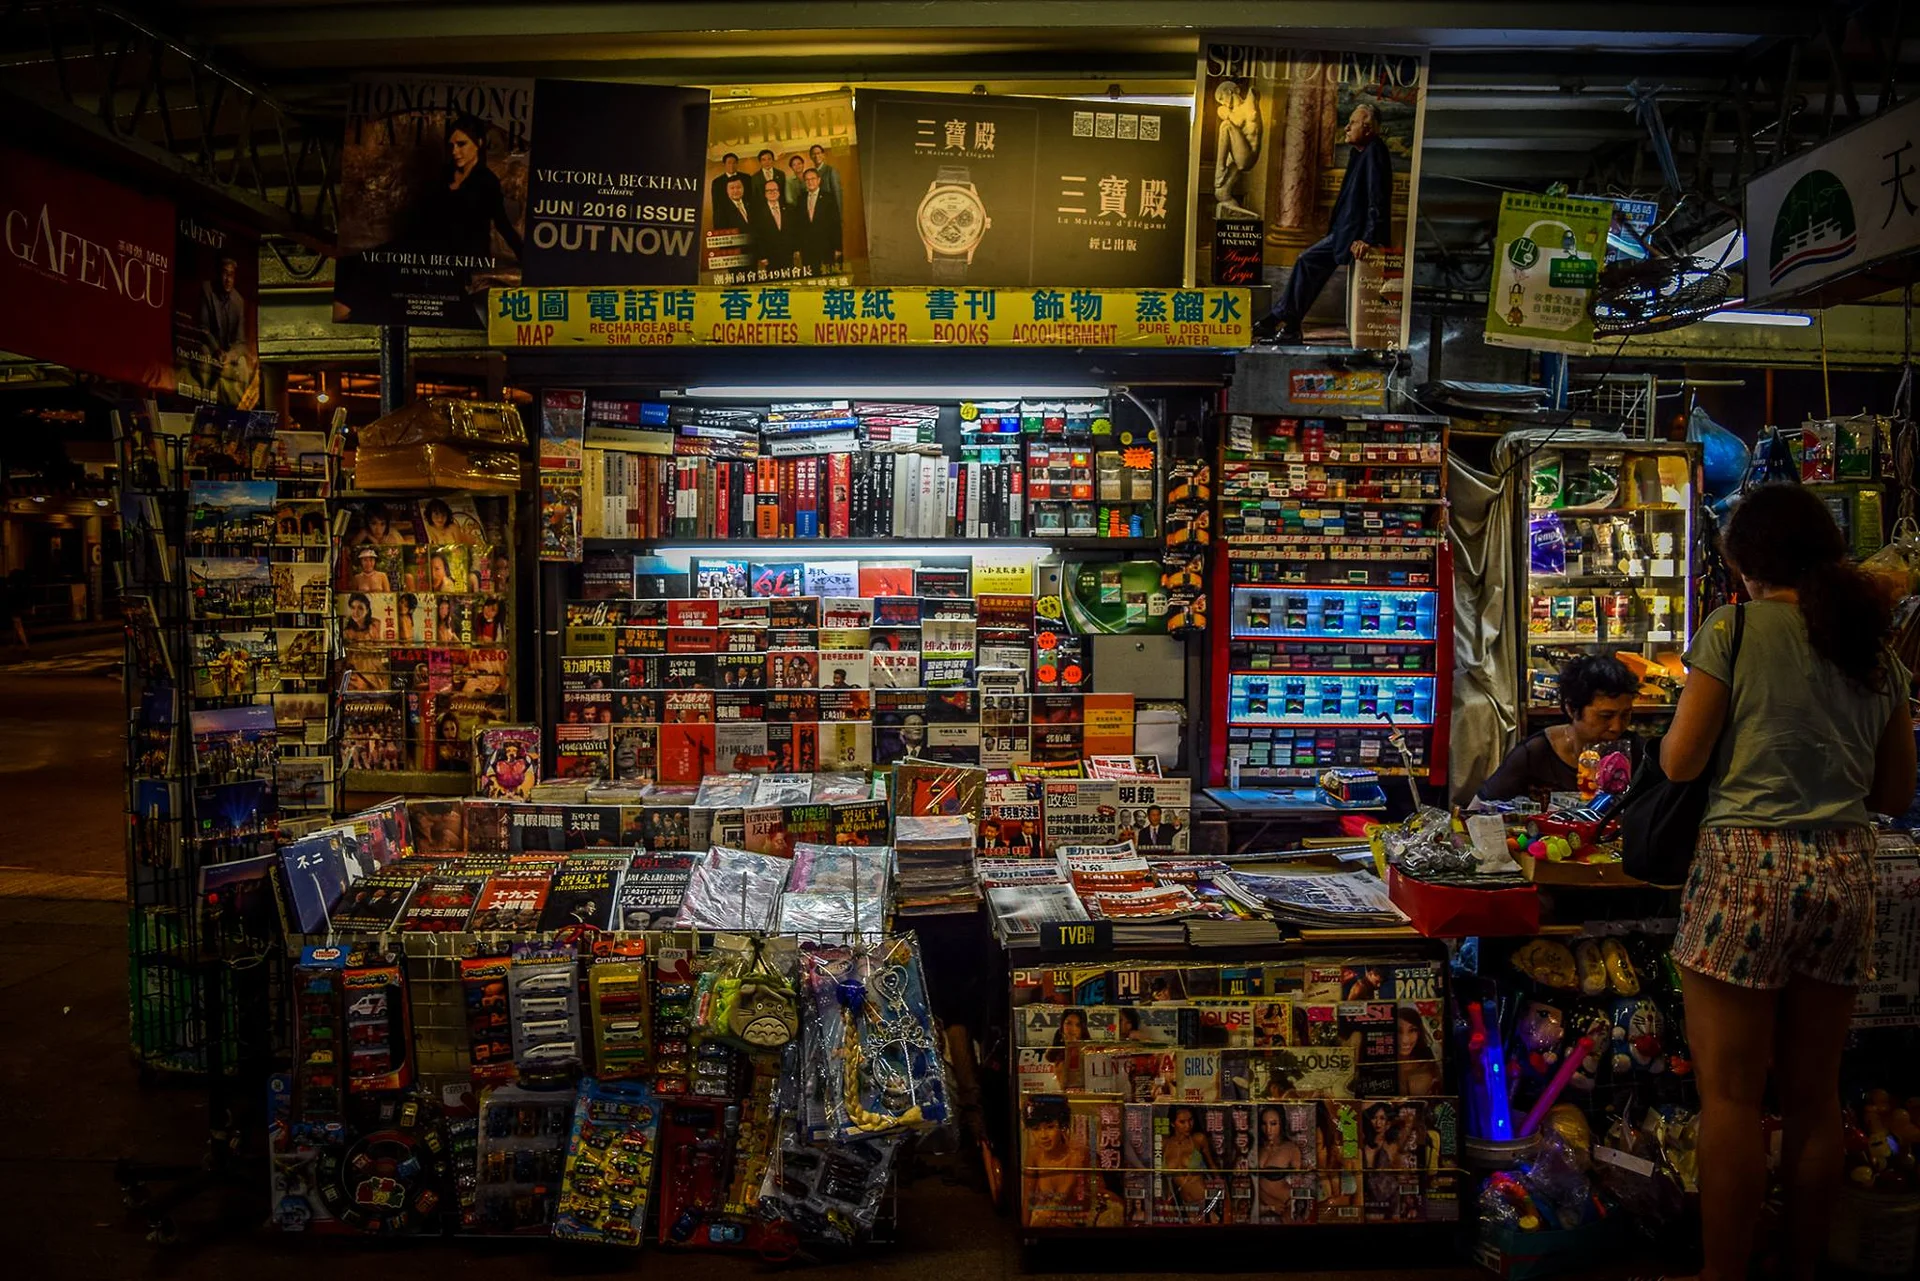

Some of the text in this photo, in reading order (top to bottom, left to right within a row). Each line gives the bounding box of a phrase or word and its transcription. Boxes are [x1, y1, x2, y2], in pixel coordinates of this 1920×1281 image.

[350, 82, 529, 121] HONG KONG
[915, 119, 996, 152] 三寶殿
[536, 169, 698, 192] VICTORIA BECKHAM
[597, 186, 634, 197] exclusive
[1057, 175, 1168, 219] 三寶殿
[533, 199, 696, 223] JUN 2016 ISSUE
[1057, 217, 1071, 226] La
[1073, 218, 1113, 228] Maison
[532, 221, 605, 250] OUT
[610, 226, 695, 258] NOW
[1088, 236, 1139, 252] 經已出版
[5, 203, 169, 309] GAFENCU
[146, 250, 169, 269] MEN
[361, 250, 497, 270] VICTORIA BECKHAM
[499, 290, 570, 322] 地圖
[586, 289, 697, 322] 電話咭
[720, 289, 792, 321] 香煙
[822, 290, 895, 321] 報紙
[925, 291, 996, 321] 書刊
[1031, 290, 1103, 321] 飾物
[1135, 291, 1242, 323] 蒸餾水
[517, 325, 554, 346] MAP
[590, 322, 691, 334] RECHARGEABLE
[712, 323, 799, 345] CIGARETTES
[814, 323, 908, 345] NEWSPAPER
[933, 323, 990, 346] BOOKS
[1012, 323, 1118, 346] ACCOUTERMENT
[1138, 323, 1242, 336] PURE DISTILLED
[607, 333, 674, 345] SIM CARD
[1165, 335, 1210, 347] WATER
[1534, 529, 1561, 546] Tempo
[827, 616, 859, 628] 習近平
[625, 629, 658, 640] 習近平
[669, 667, 696, 677] 大決戰
[1119, 786, 1155, 804] 明鏡
[513, 813, 564, 827] 真假間諜
[571, 812, 600, 822] 五中全會
[841, 808, 879, 821] 習近平
[571, 821, 600, 831] 大決戰
[559, 872, 608, 886] 習近平
[493, 889, 541, 900] 十九大
[620, 895, 683, 906] 攻守同盟
[1058, 926, 1085, 945] TVB
[547, 956, 571, 964] EXPRESS
[1184, 1057, 1214, 1076] GIRLS
